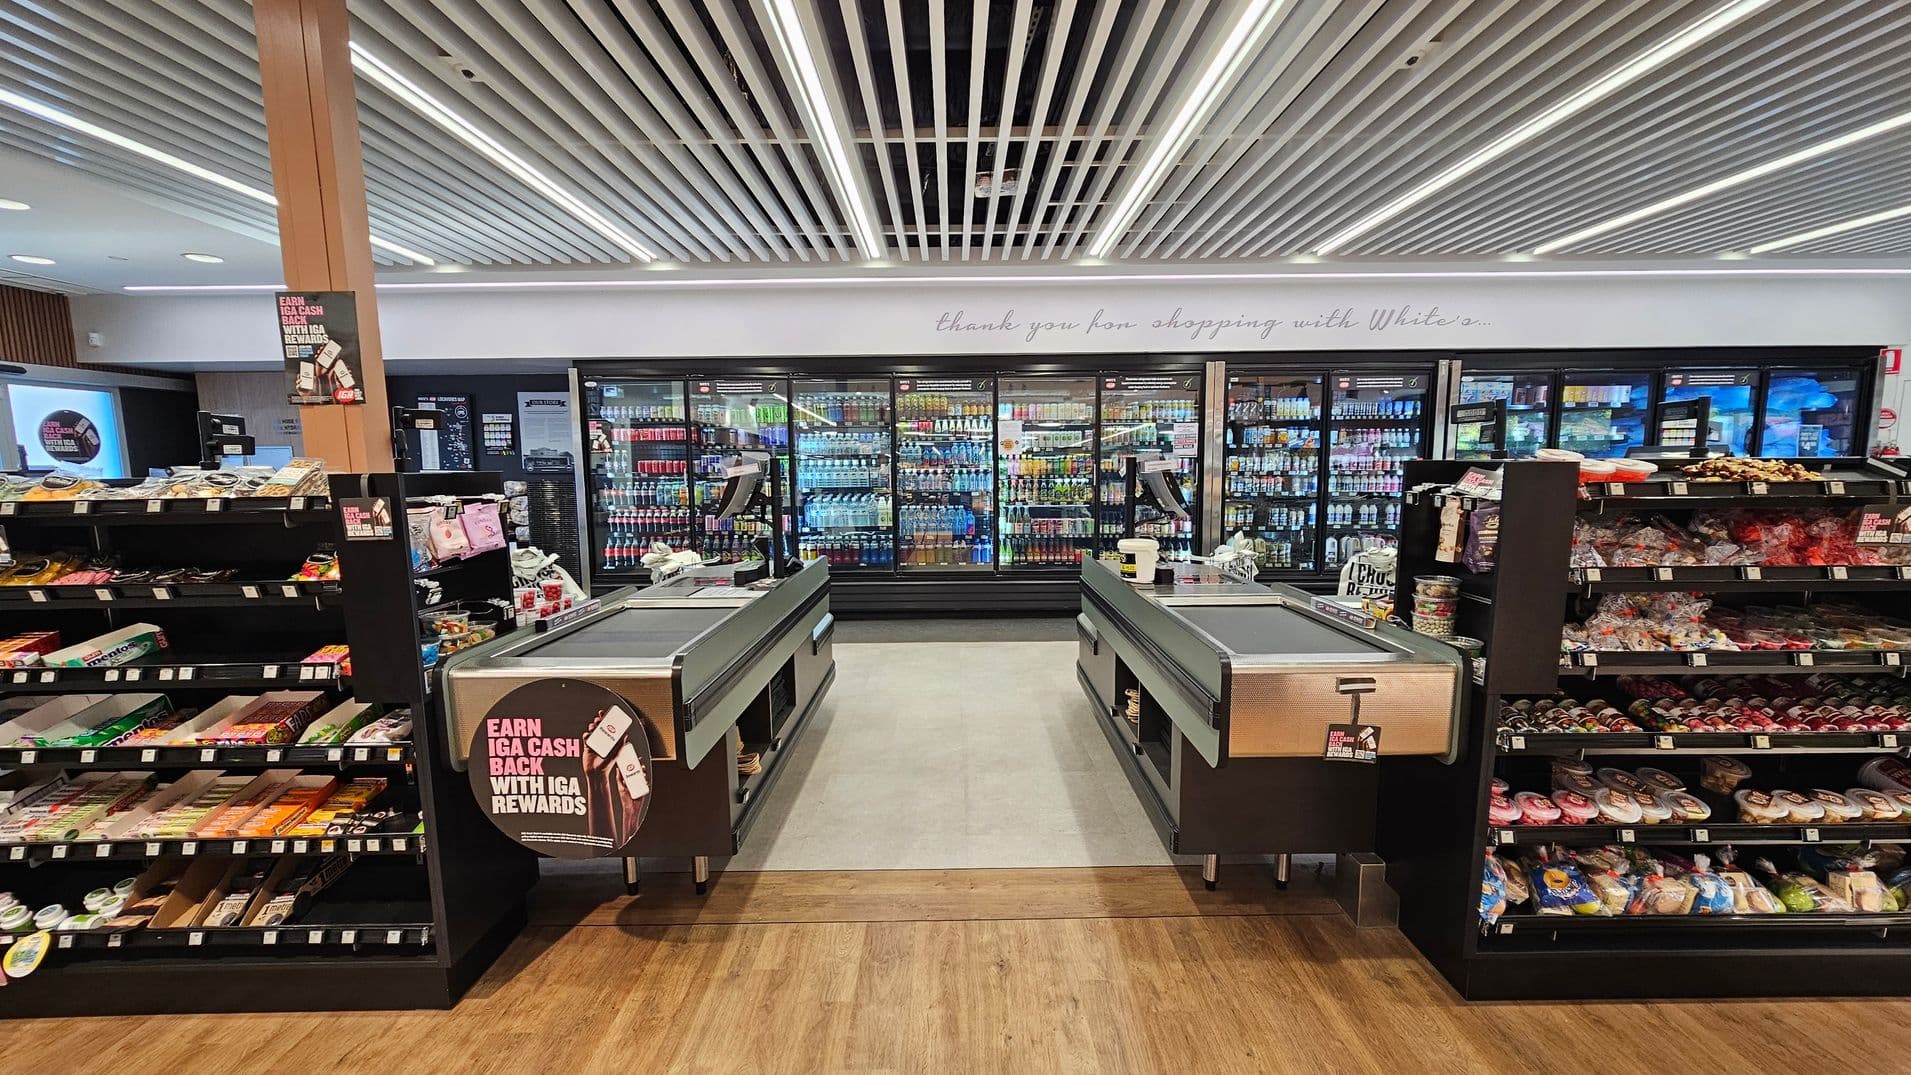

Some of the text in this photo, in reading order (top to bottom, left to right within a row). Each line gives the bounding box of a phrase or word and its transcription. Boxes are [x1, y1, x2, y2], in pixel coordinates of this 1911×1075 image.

[279, 296, 304, 306] EARN
[280, 306, 324, 316] IGA CASH
[281, 316, 307, 325] BACK
[935, 310, 1021, 332] thank
[1025, 321, 1080, 342] you
[1086, 309, 1137, 334] for
[1151, 307, 1283, 341] shopping
[1293, 307, 1360, 329] with
[283, 325, 325, 334] WITH IGA
[284, 335, 329, 344] REWARDS
[337, 390, 354, 400] IGA
[86, 640, 138, 667] mentos
[487, 718, 541, 737] EARN
[488, 738, 580, 757] IGA CASH
[489, 757, 544, 776] BACK
[490, 776, 581, 796] WITH IGA
[491, 795, 587, 816] REWARDS
[216, 901, 223, 912] 1
[263, 904, 270, 915] 1
